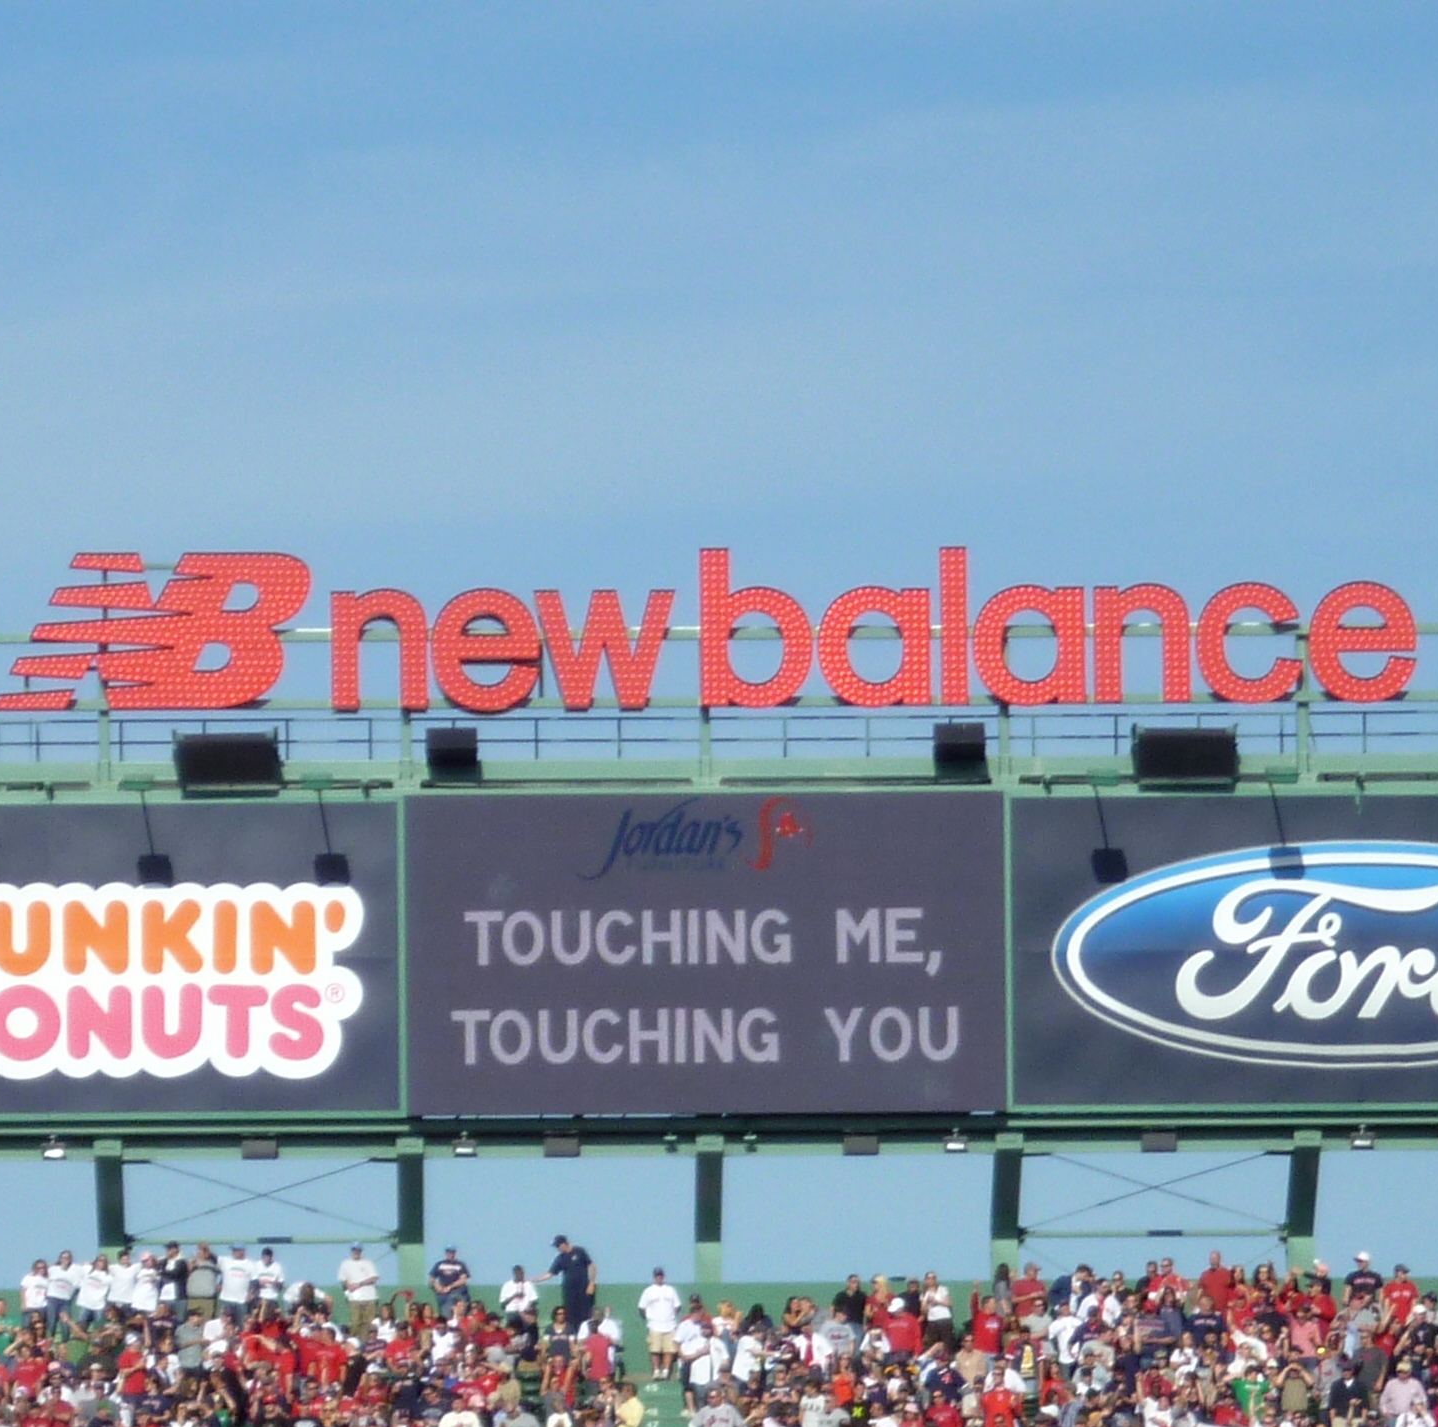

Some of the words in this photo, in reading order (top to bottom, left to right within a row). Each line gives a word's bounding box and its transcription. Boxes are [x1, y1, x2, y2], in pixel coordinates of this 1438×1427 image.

[330, 586, 676, 713] new
[697, 546, 1419, 706] balance
[463, 907, 792, 966] TOUCHING
[834, 907, 943, 976] ME,
[450, 1007, 780, 1066] TOUCHING
[823, 1006, 960, 1063] YOU
